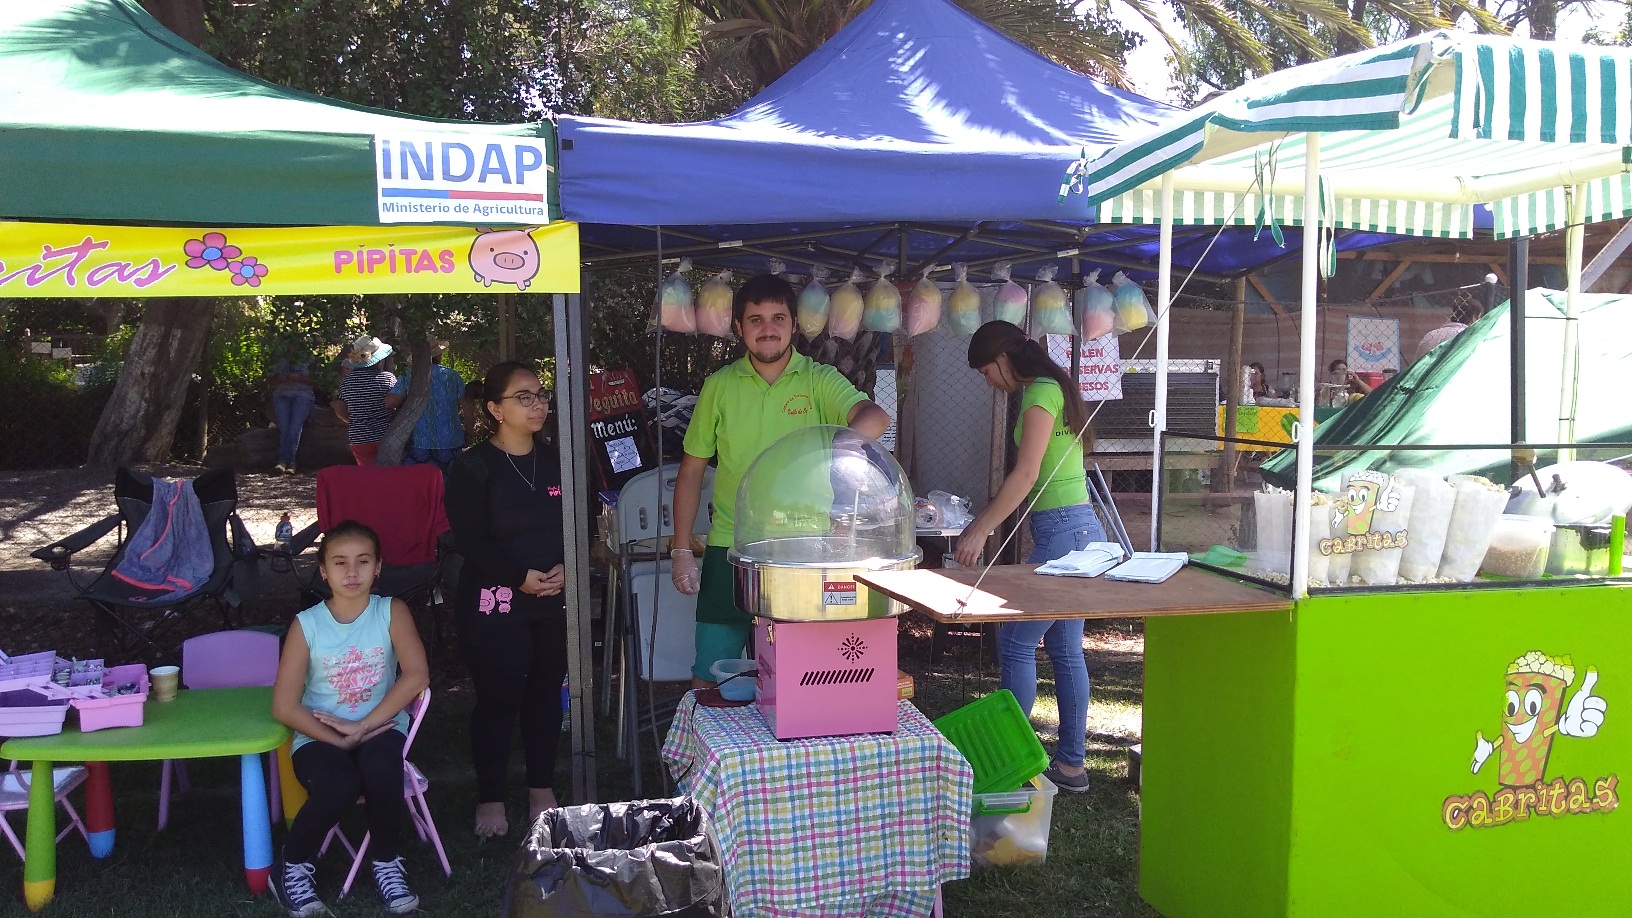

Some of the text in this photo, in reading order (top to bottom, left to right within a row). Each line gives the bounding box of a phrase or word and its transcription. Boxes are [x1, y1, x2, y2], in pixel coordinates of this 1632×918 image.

[381, 139, 544, 185] INDAP
[382, 202, 545, 217] Ministerio de Agricultura
[590, 389, 638, 414] eguita
